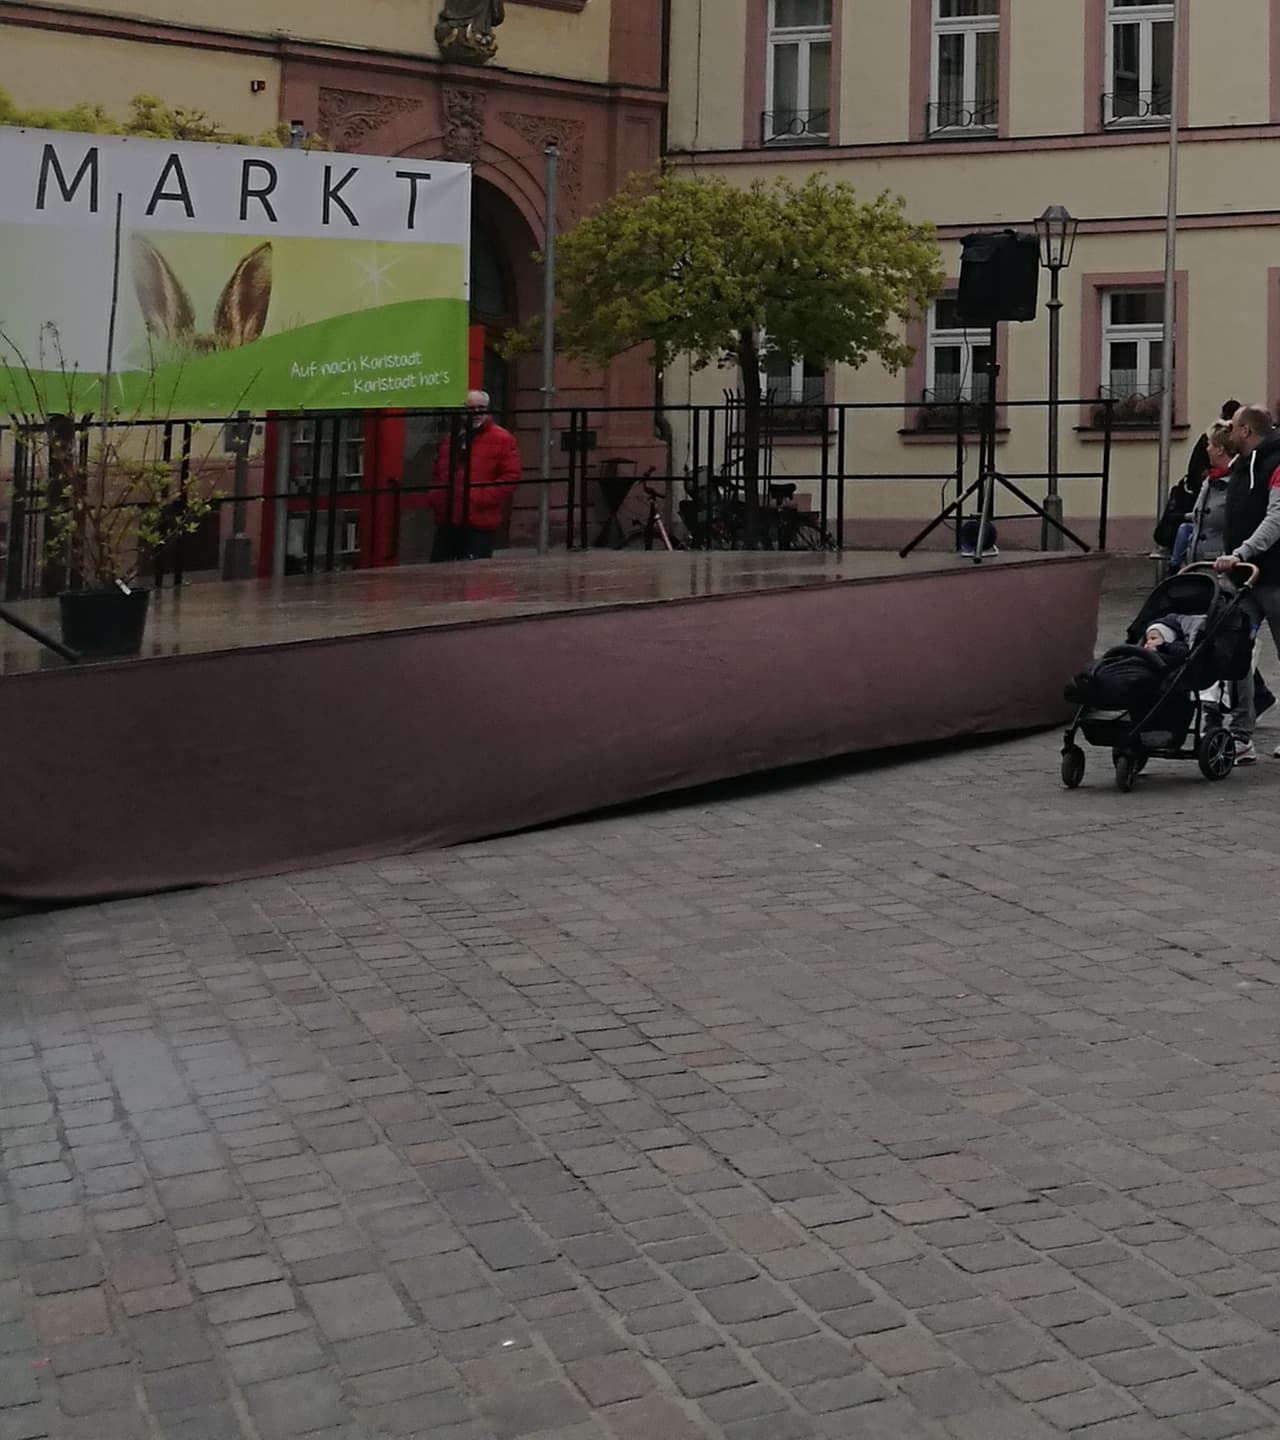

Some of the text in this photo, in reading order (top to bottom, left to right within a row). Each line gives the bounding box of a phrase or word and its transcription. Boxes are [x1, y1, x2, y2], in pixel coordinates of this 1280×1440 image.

[35, 143, 431, 229] MARKT
[290, 351, 424, 379] Auf nach Karlstadt
[353, 374, 417, 393] Karlstadt
[419, 371, 450, 386] hat's
